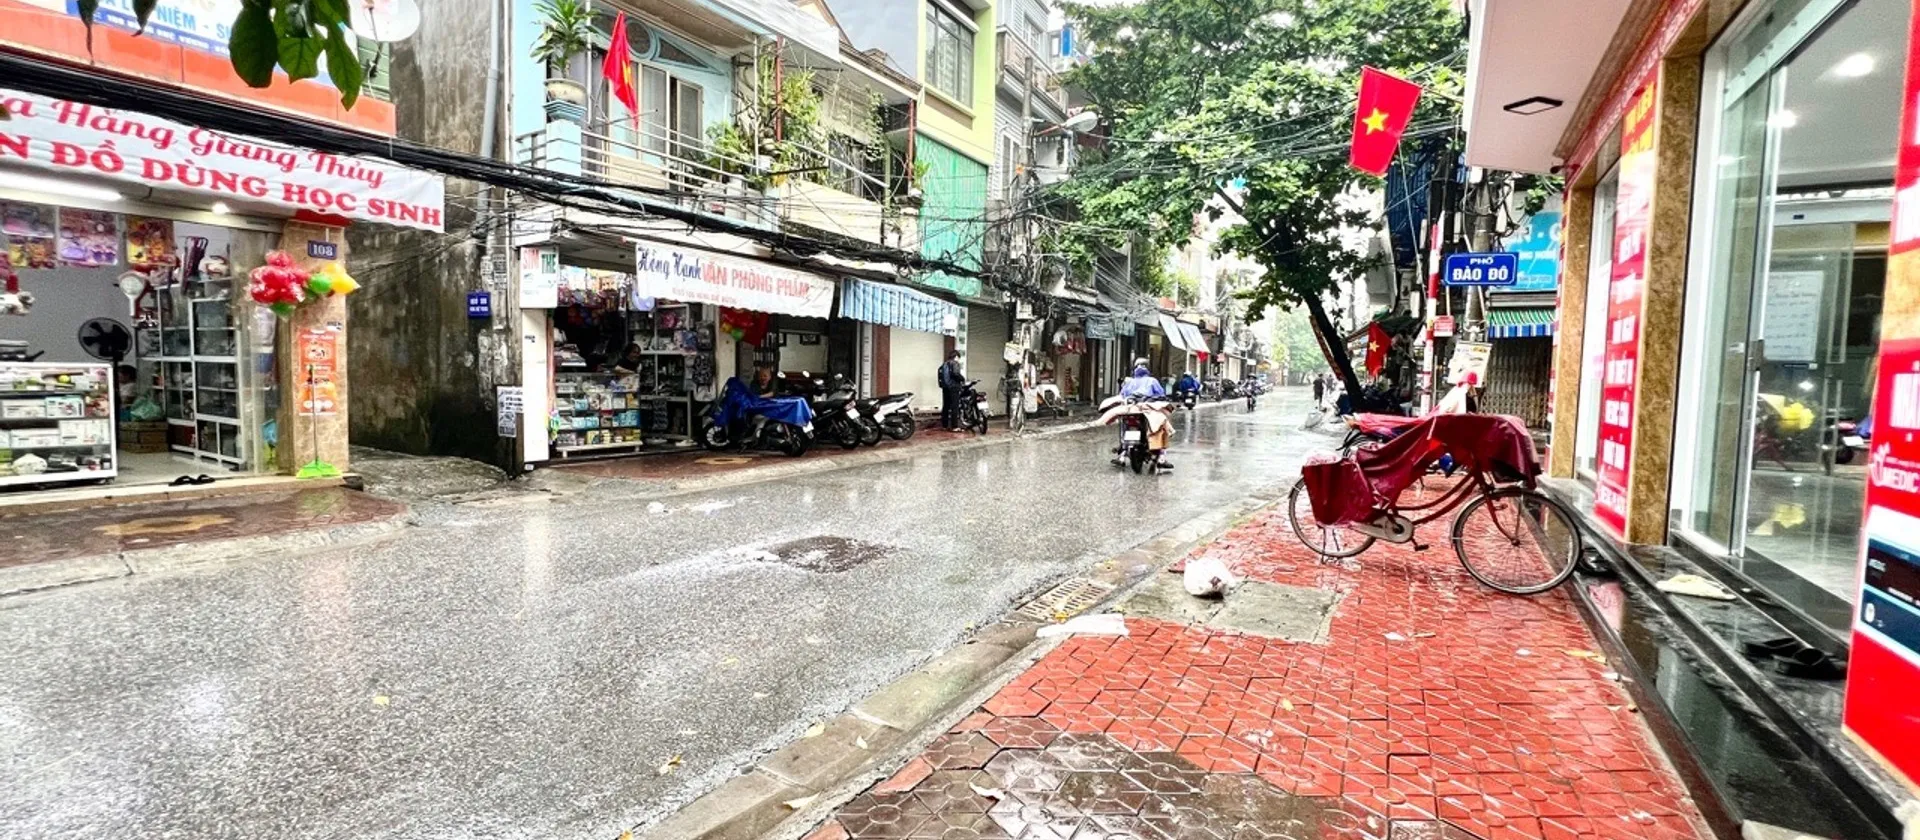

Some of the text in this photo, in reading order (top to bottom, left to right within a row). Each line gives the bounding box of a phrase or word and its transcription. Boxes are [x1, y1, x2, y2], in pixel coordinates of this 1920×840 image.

[156, 4, 196, 31] NIỆM
[51, 99, 179, 150] Hàng
[188, 126, 300, 173] Giang
[51, 140, 125, 173] ĐỒ
[140, 157, 269, 197] DÙNG
[281, 182, 357, 213] HỌC
[367, 199, 441, 227] SINH
[312, 243, 333, 258] 108
[1470, 256, 1494, 265] PHỐ
[703, 261, 727, 286] VĂN
[731, 268, 773, 294] PHÒNG
[1452, 265, 1482, 281] ĐÀO
[1487, 265, 1509, 281] ĐÔ
